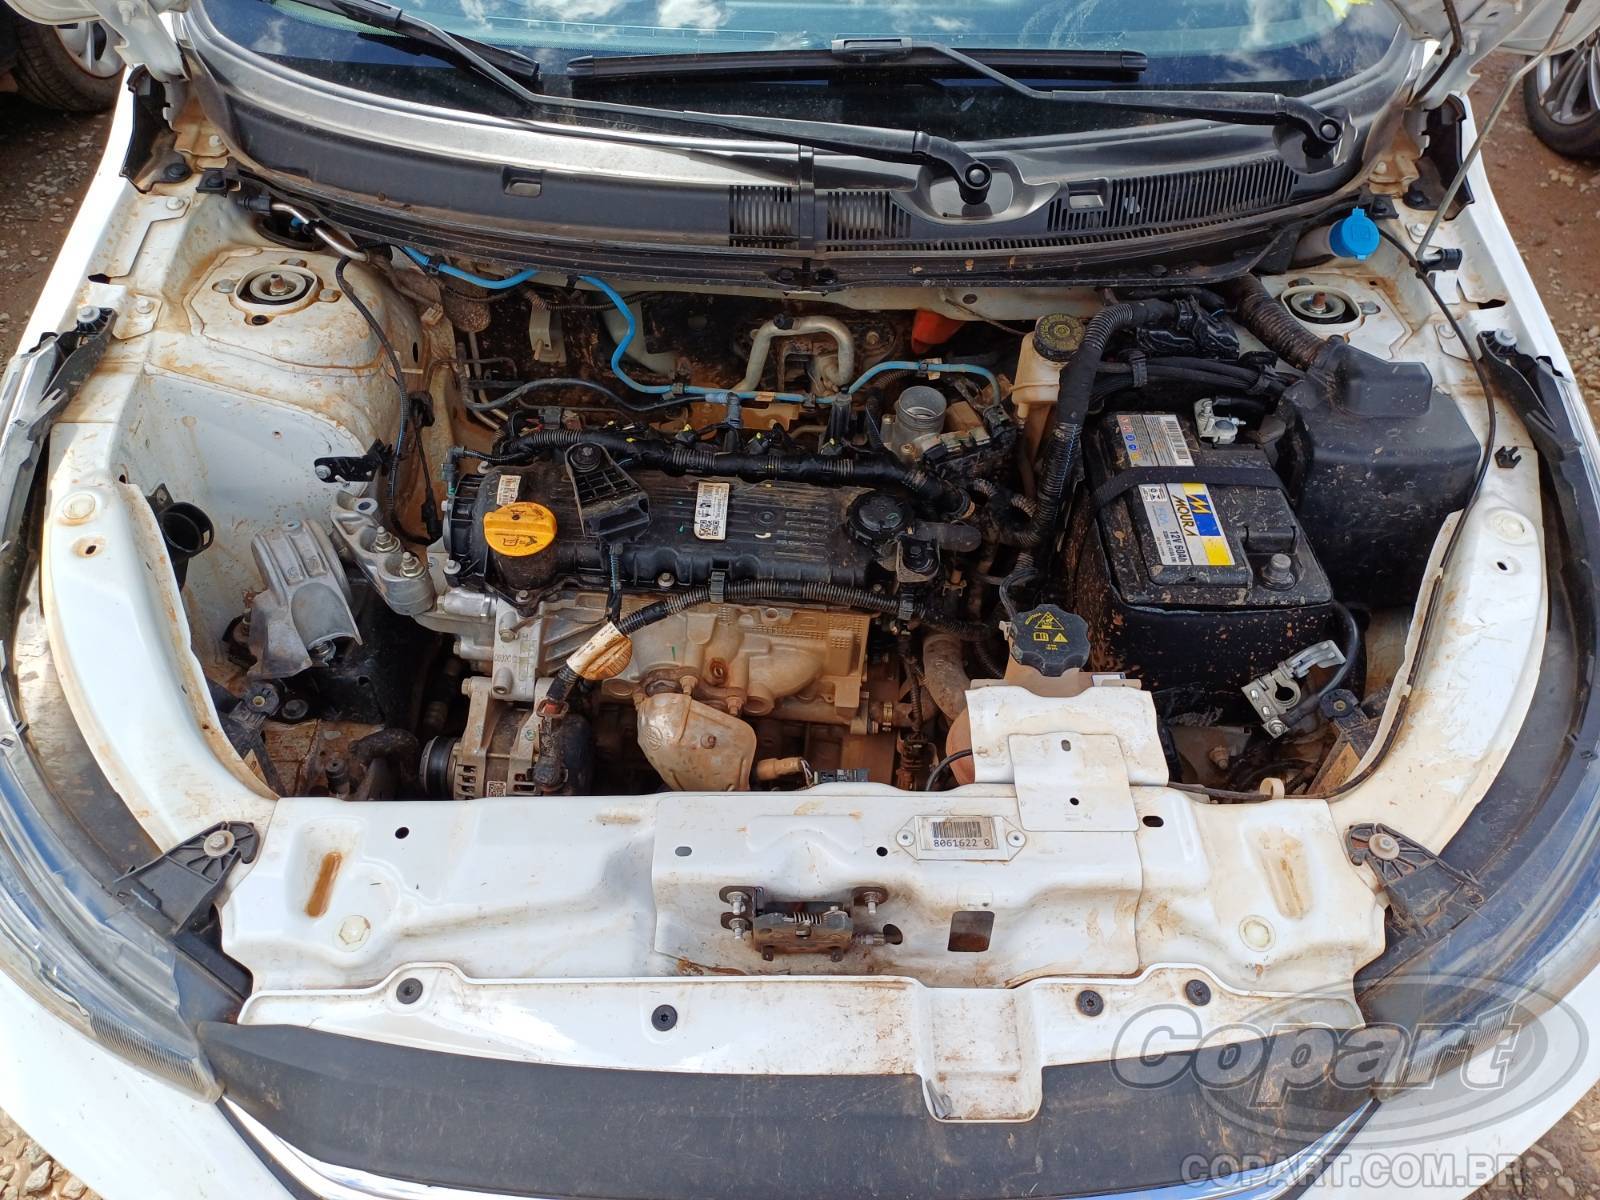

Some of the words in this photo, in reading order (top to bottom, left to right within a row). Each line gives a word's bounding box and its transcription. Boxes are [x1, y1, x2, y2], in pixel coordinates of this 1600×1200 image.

[1171, 494, 1199, 536] MOURA
[1168, 530, 1183, 543] 12V
[933, 838, 978, 848] 8061622
